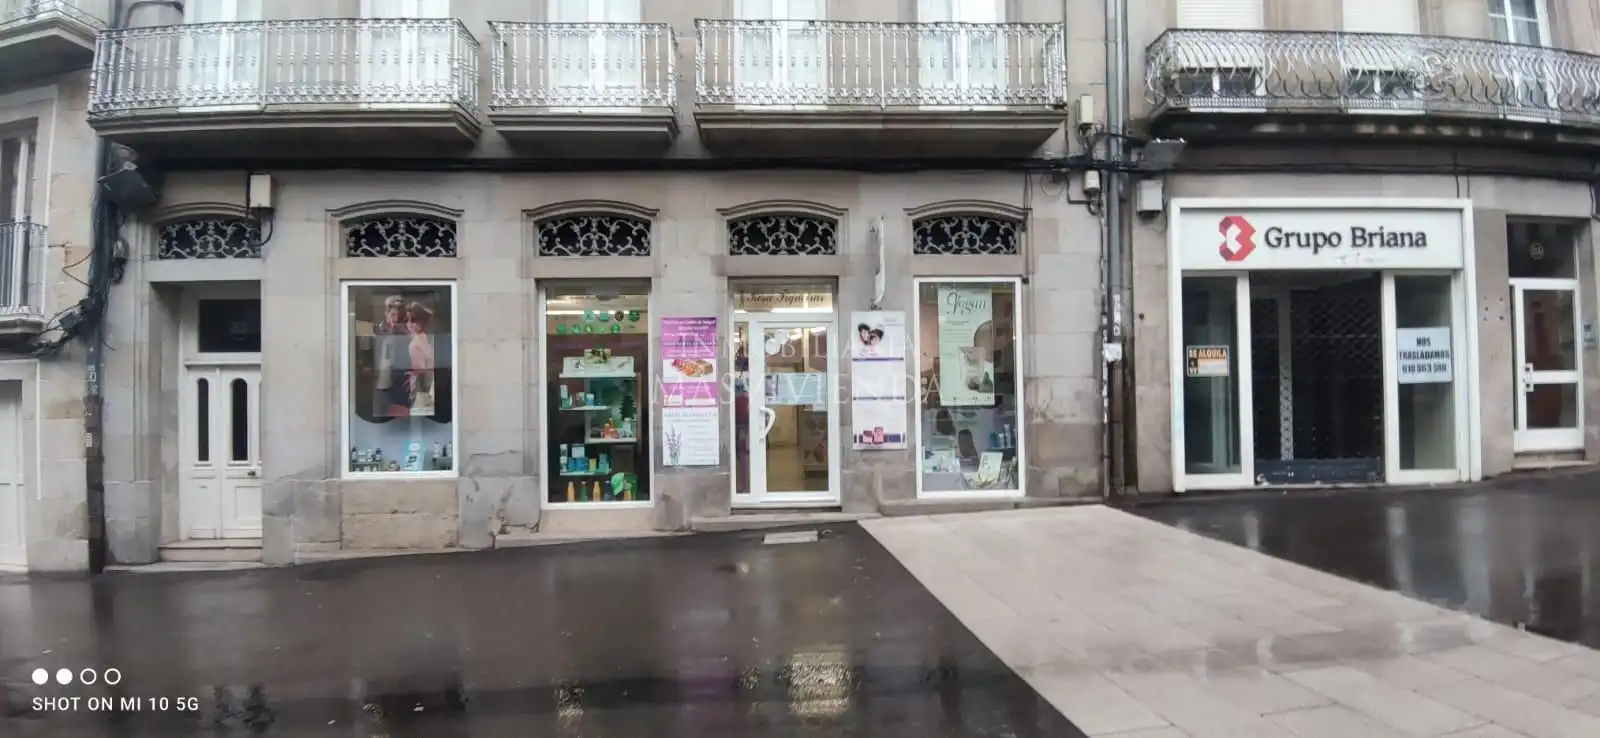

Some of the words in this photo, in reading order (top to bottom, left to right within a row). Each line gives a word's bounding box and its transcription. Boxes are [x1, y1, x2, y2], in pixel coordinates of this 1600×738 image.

[1264, 227, 1342, 254] Grupo
[1349, 225, 1427, 248] Briana
[1416, 337, 1431, 347] NOS
[1199, 348, 1227, 359] ALQUILA
[1399, 350, 1450, 360] TRASLADAMOS
